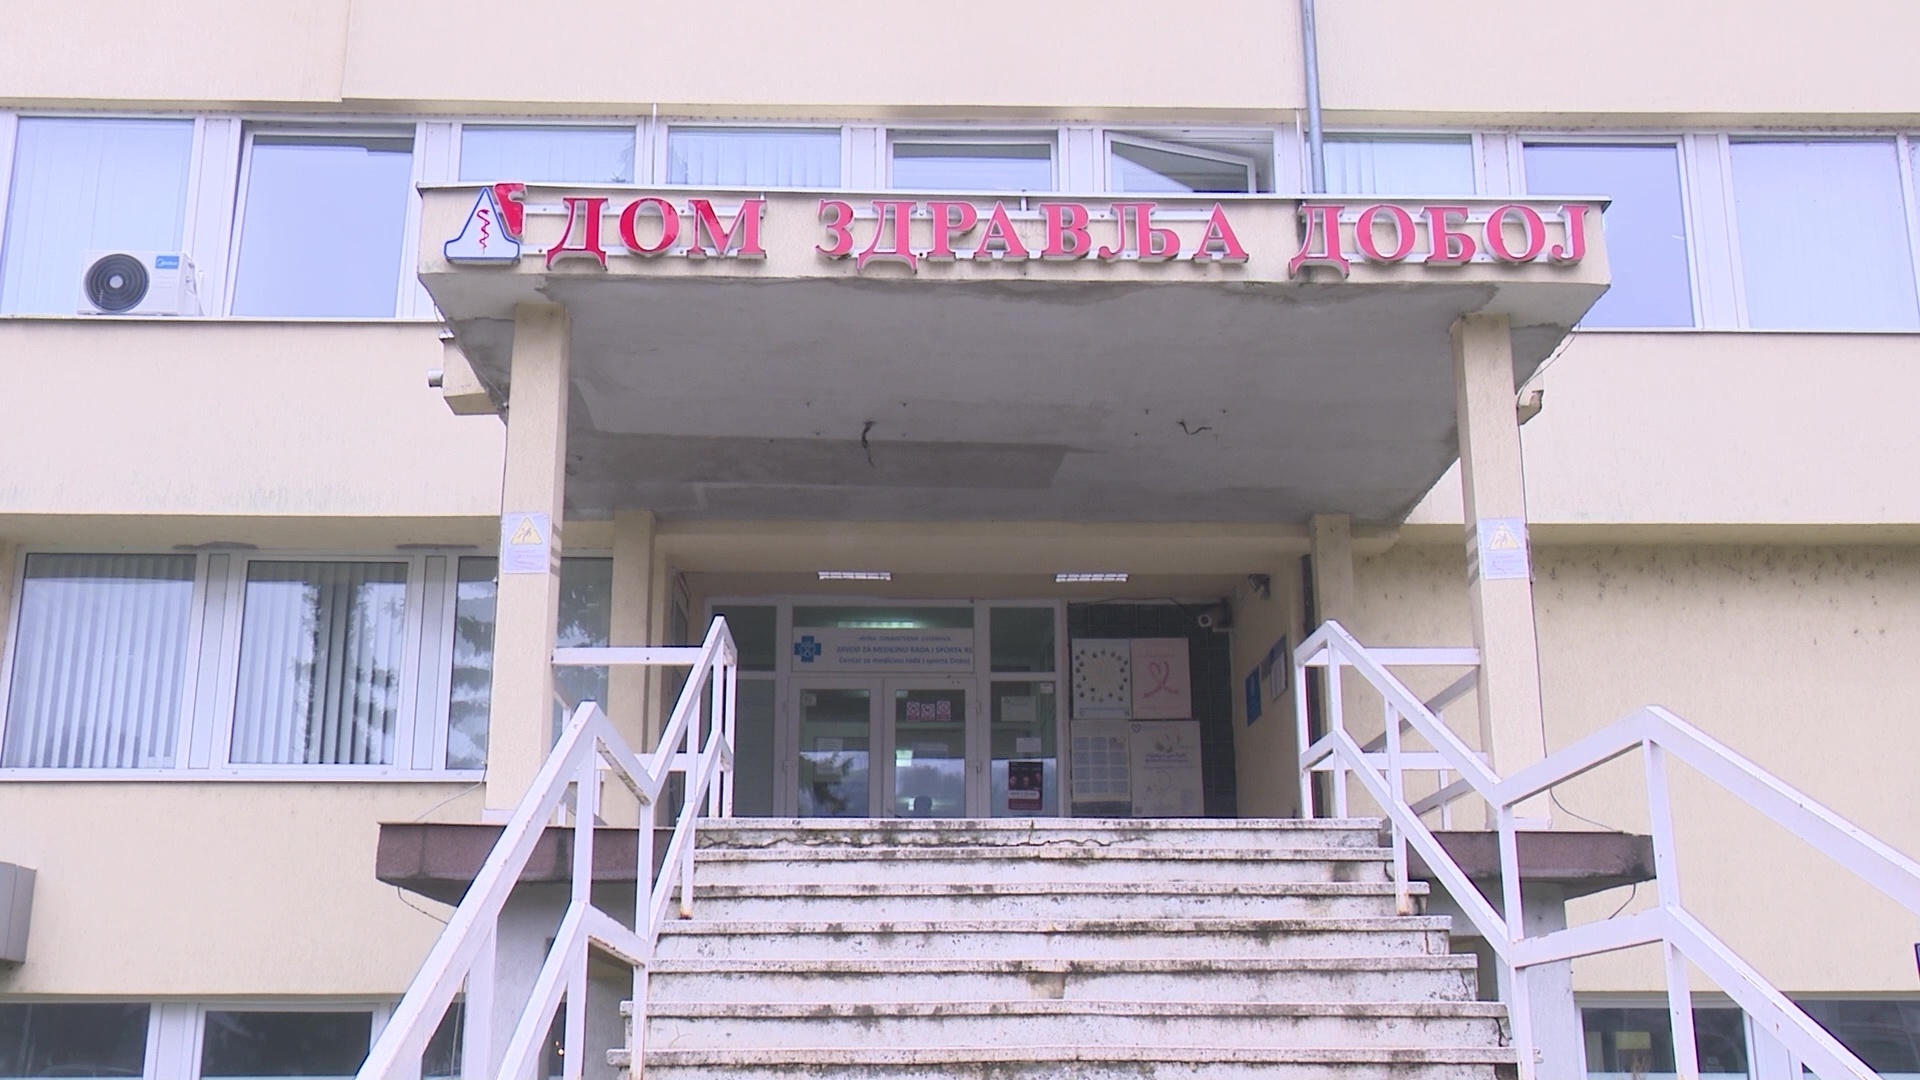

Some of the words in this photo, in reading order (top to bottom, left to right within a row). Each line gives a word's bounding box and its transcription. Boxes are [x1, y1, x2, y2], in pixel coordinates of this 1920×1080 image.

[546, 197, 768, 271] ДОМ
[815, 199, 1250, 274] ЗДРАВЉА
[1288, 204, 1590, 279] ДОБОЈ
[936, 646, 962, 654] SPORTA
[839, 656, 862, 664] Centar
[872, 656, 905, 664] medicinu
